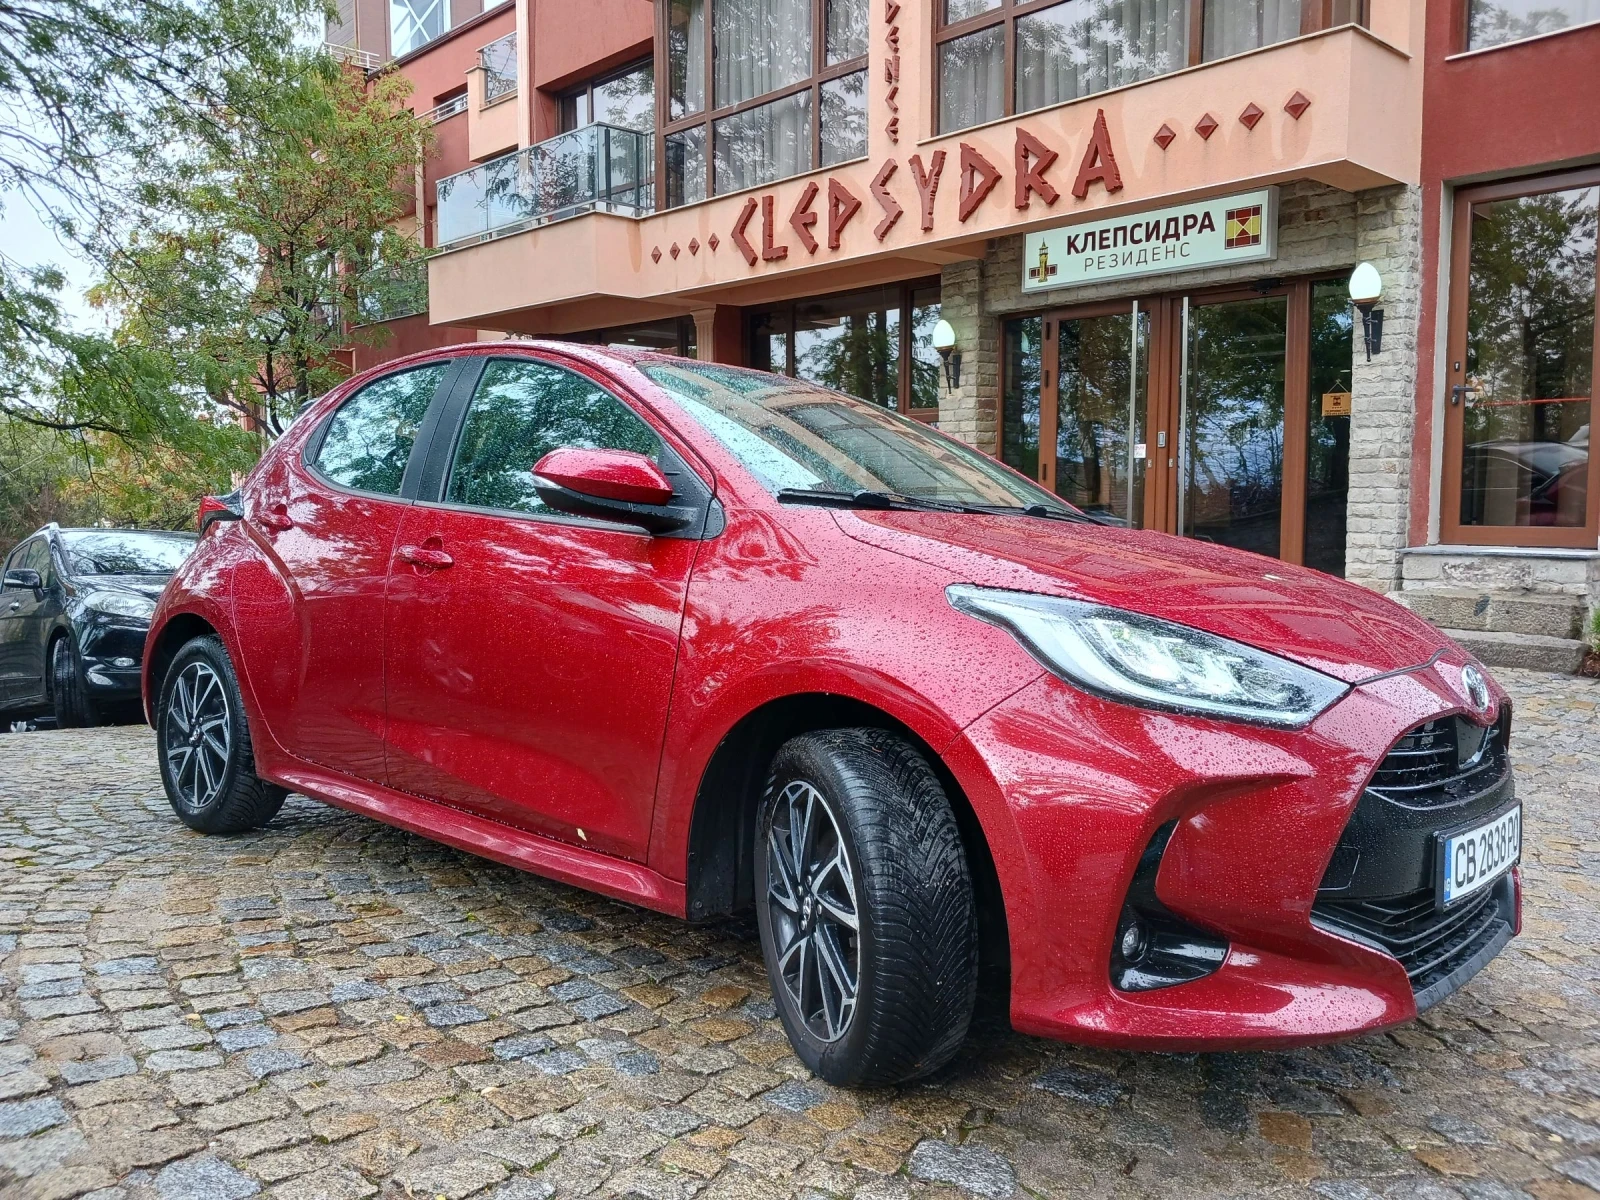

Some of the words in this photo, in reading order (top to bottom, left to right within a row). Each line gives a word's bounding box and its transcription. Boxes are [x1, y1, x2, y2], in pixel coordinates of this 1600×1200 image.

[731, 108, 1123, 266] CLEPSYDRA
[1067, 210, 1216, 256] КЛЕПСИДРА
[1084, 242, 1191, 272] РЕЗИДЕНС
[1455, 838, 1477, 889] CB
[1479, 821, 1507, 878] 2838
